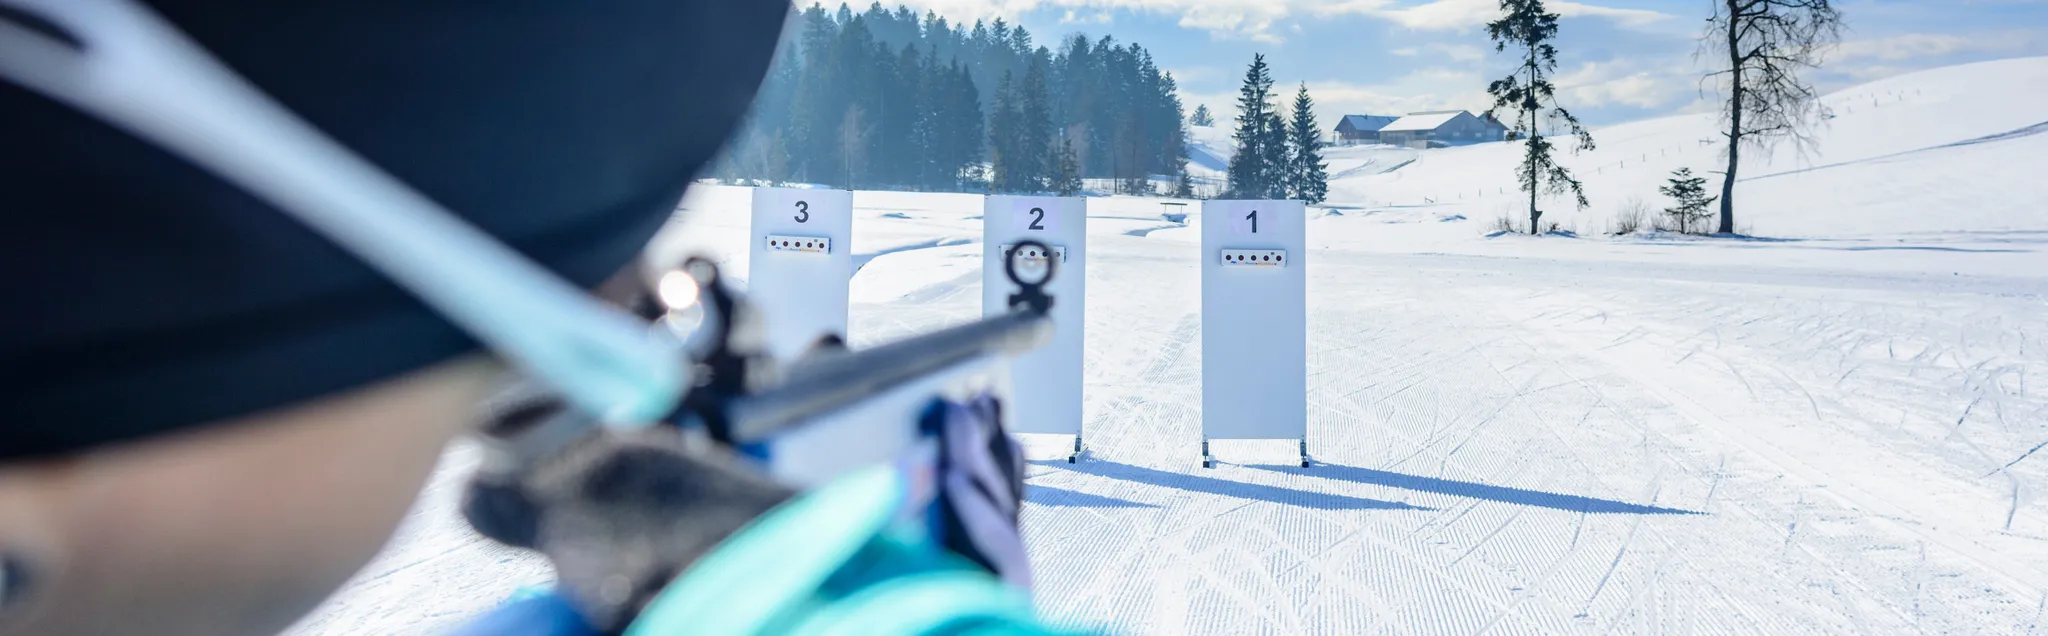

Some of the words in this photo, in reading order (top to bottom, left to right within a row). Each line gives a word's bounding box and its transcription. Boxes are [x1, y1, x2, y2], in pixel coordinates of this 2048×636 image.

[794, 201, 809, 223] 3
[1028, 207, 1045, 230] 2
[1246, 210, 1257, 233] 1
